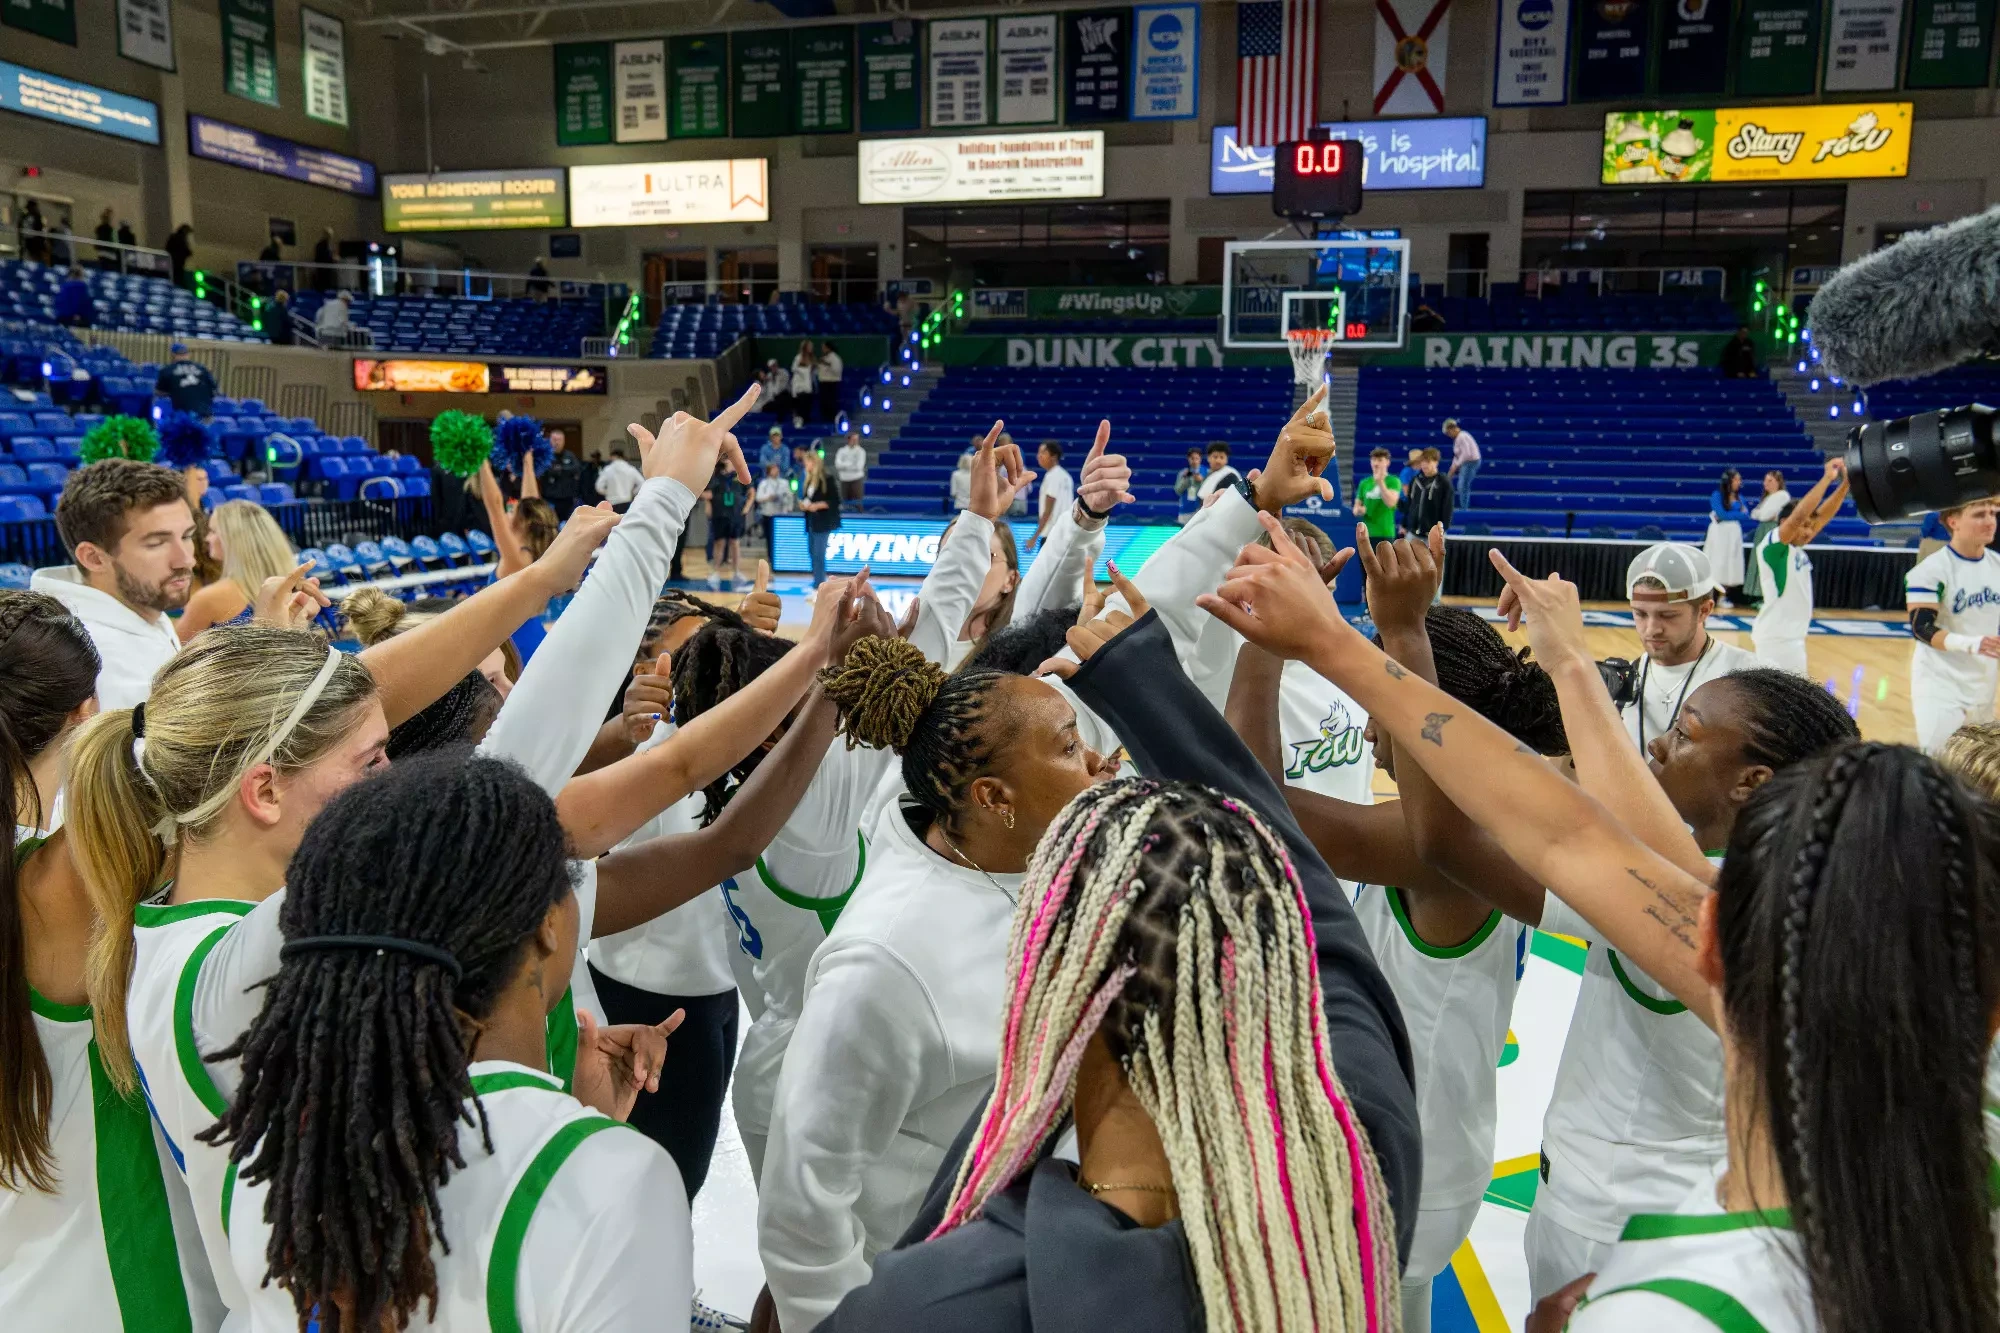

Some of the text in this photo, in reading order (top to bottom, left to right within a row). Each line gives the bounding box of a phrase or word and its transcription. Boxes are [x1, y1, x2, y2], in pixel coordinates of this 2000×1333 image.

[1392, 128, 1412, 152] is
[1728, 123, 1892, 164] Starry FGCU
[882, 151, 934, 168] Allen
[1298, 145, 1340, 173] 0.0
[1380, 145, 1480, 181] hospital.
[390, 179, 556, 199] YOUR HOMETOWN ROOFER
[657, 174, 725, 192] ULTRA
[1058, 292, 1164, 313] #WingsUp
[1007, 338, 1226, 368] DUNK CITY
[1424, 336, 1638, 368] RAINING
[1285, 727, 1364, 779] FGCU
